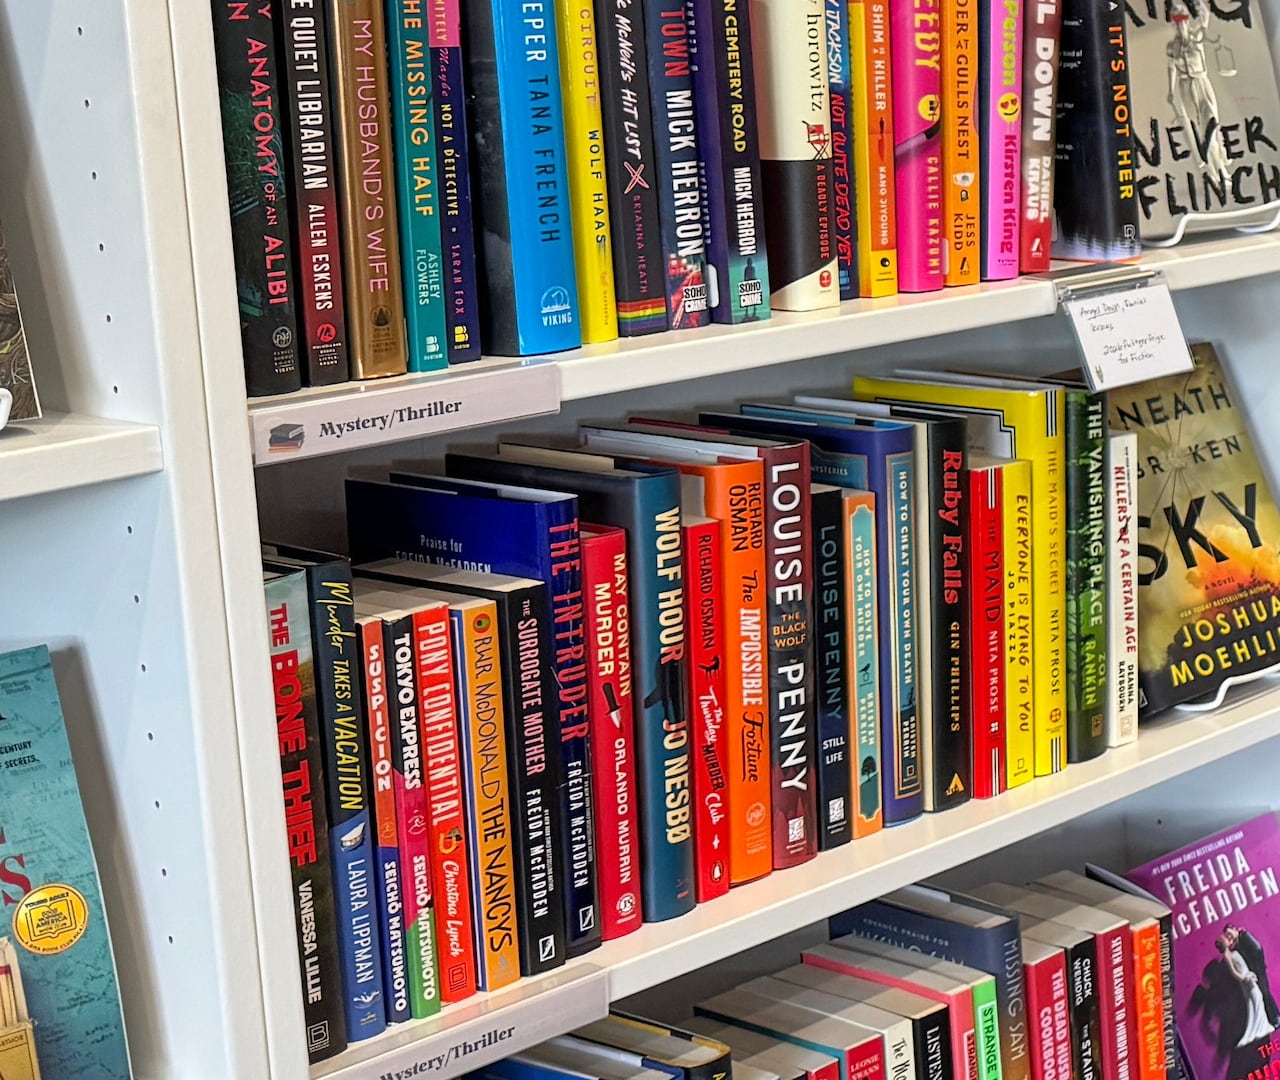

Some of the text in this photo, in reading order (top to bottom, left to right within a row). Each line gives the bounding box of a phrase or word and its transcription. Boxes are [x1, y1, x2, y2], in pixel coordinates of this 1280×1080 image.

[291, 16, 317, 75] QUIET
[661, 4, 690, 78] TOWN
[806, 14, 824, 113] horowitz
[1033, 37, 1056, 142] DOWN
[295, 79, 327, 191] LIBRARIAN
[352, 18, 388, 294] MY HUSBAND'S WIFE
[527, 75, 554, 136] TANA
[666, 89, 696, 155] MICK
[1108, 25, 1133, 201] IT'S NOT HER
[1132, 116, 1278, 169] NEVER
[533, 144, 561, 244] FRENCH
[671, 161, 702, 258] HERRON
[542, 311, 572, 326] VIKING
[319, 400, 463, 439] Mystery/Thriller
[771, 462, 803, 605] LOUISE
[942, 449, 964, 605] Ruby Falls
[1138, 483, 1261, 585] SKY
[368, 644, 391, 794] SUSPICION
[393, 633, 422, 790] TOKYO EXPRESS
[654, 507, 691, 846] WOLF HOUR JO NESBØ
[776, 660, 809, 792] PENNY
[269, 602, 317, 868] THE BONE THIEF
[1164, 846, 1250, 904] FREIDA
